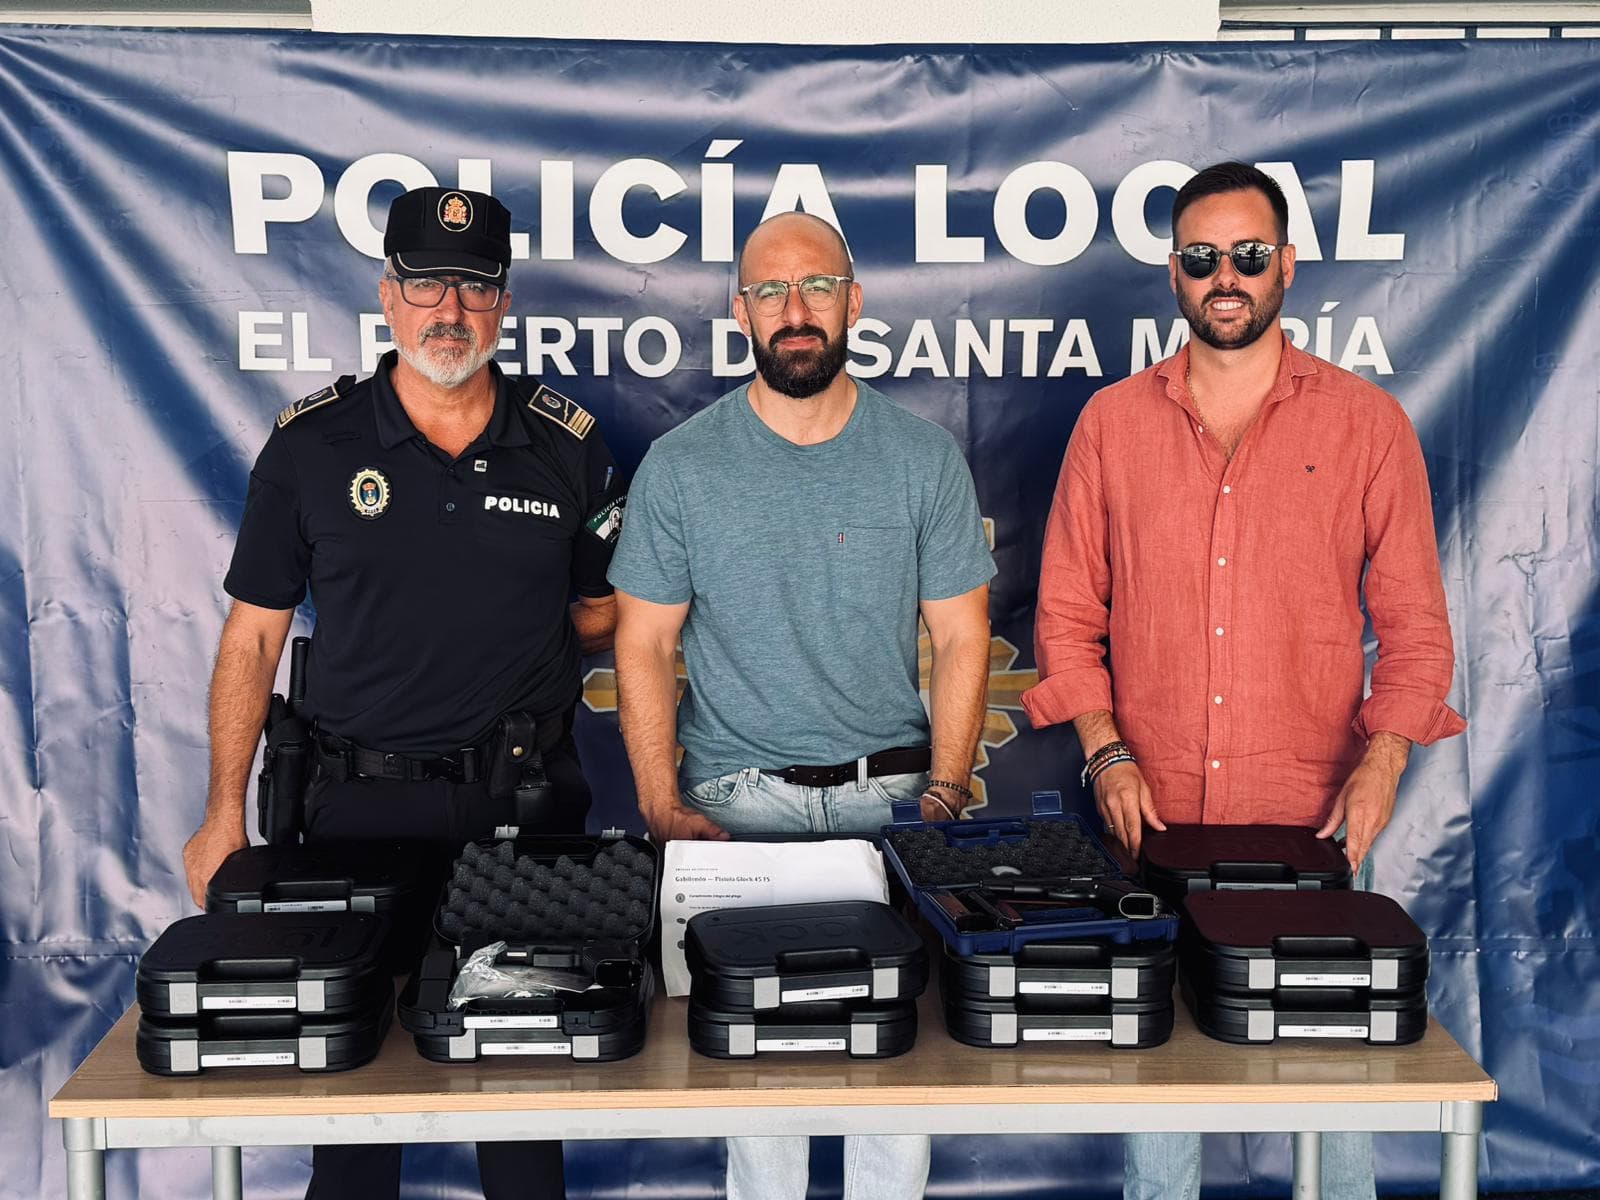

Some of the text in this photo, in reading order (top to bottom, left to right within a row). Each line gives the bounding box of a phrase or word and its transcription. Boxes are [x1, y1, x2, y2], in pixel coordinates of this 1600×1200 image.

[238, 301, 1394, 378] EL PERTO D SANTA MÍA
[484, 495, 560, 519] POLICIA
